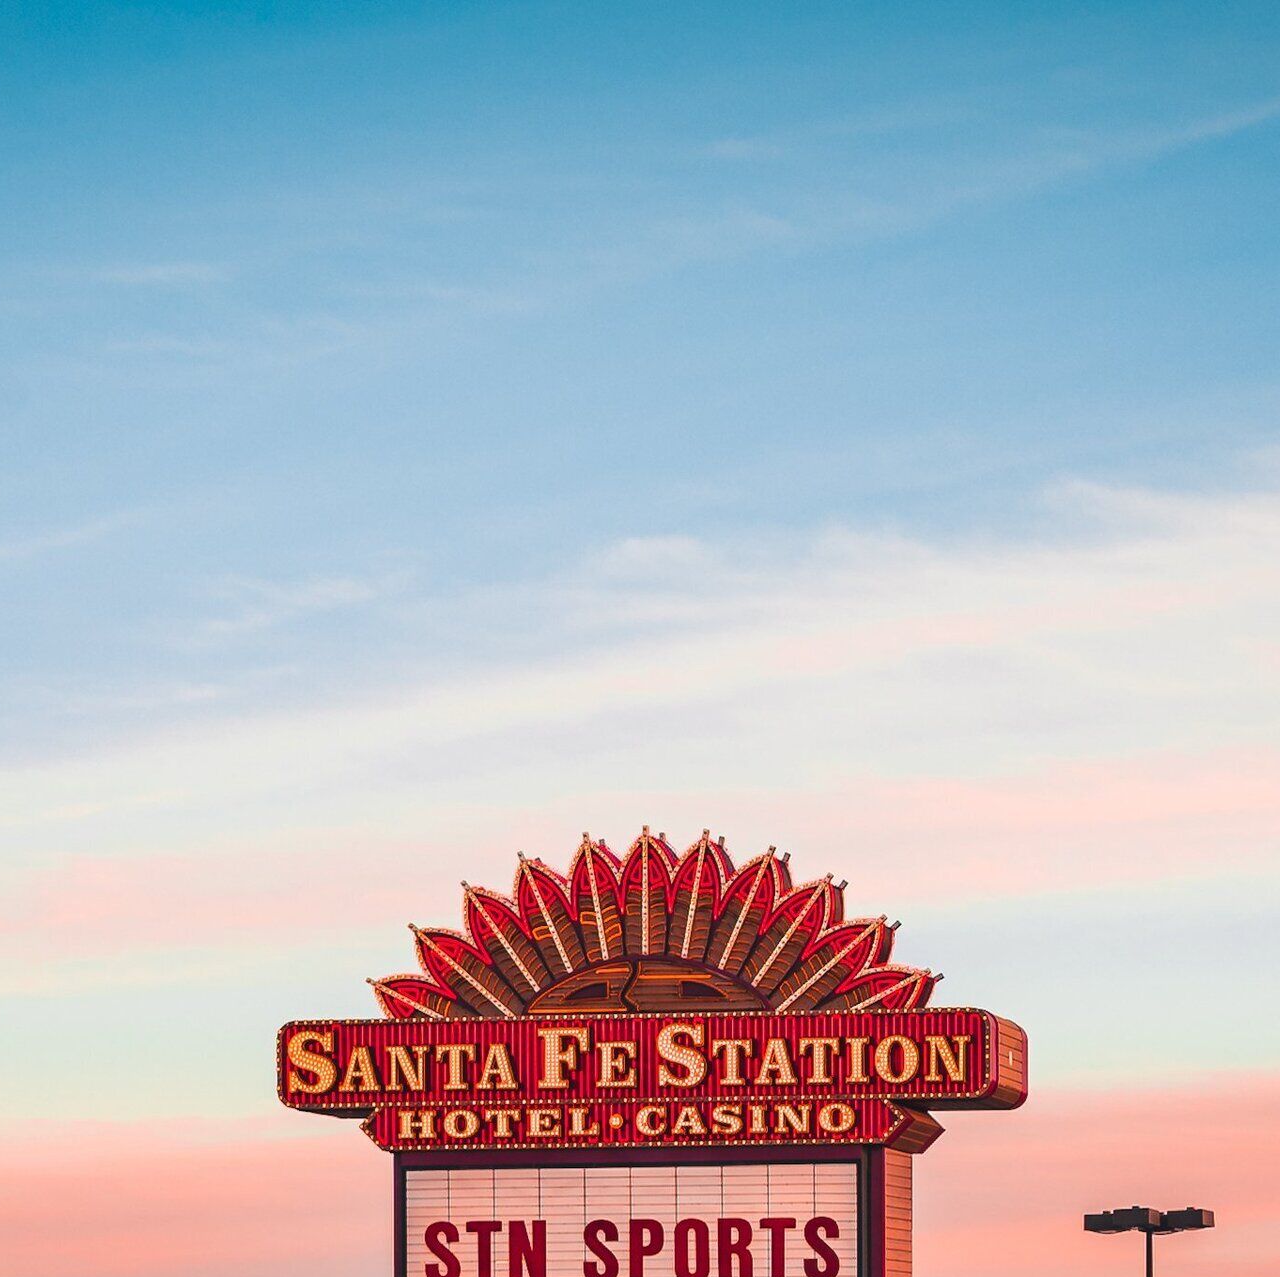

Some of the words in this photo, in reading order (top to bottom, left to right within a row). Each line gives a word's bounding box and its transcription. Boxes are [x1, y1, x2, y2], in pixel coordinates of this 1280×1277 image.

[287, 1029, 519, 1094] SANTA
[537, 1027, 638, 1090] FE
[656, 1022, 971, 1089] STATION
[397, 1107, 600, 1140] HOTEL
[635, 1102, 856, 1136] CASINO
